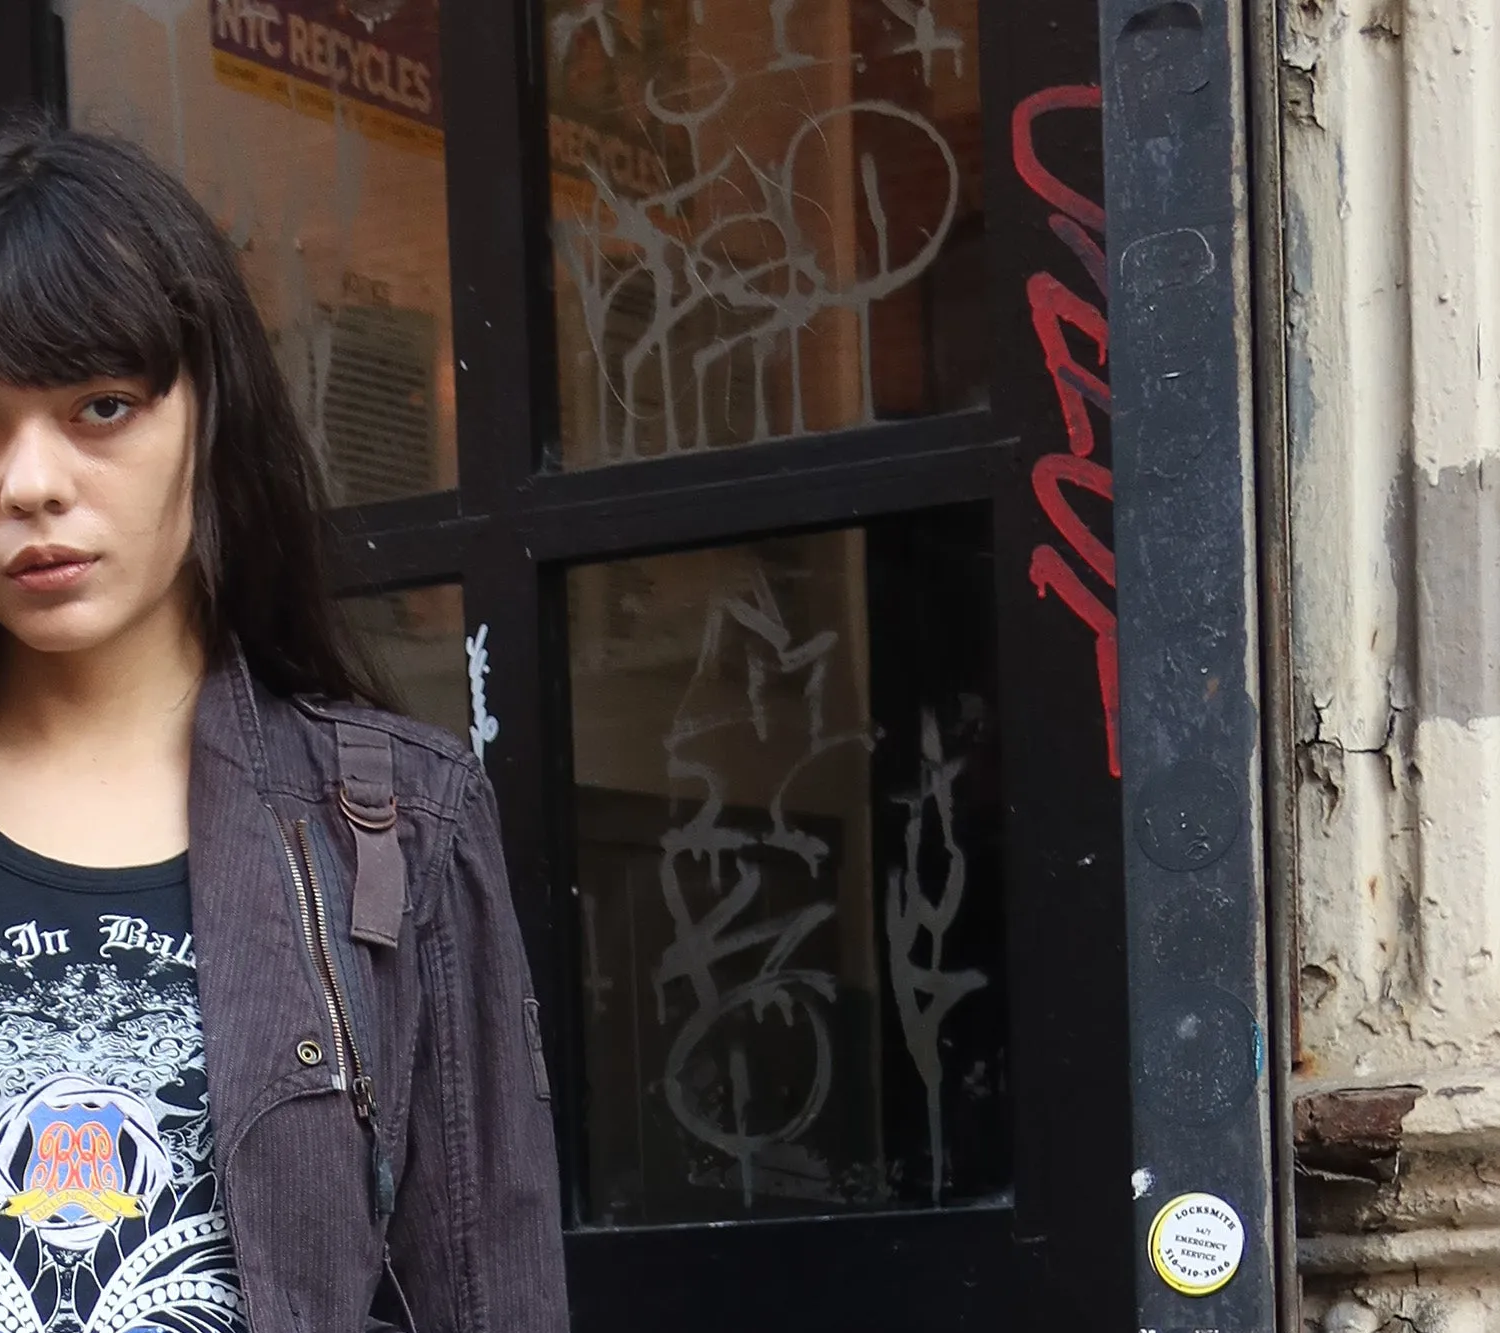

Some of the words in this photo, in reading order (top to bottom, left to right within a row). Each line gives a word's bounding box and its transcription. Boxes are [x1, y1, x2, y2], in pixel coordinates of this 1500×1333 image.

[212, 0, 284, 59] NYC
[288, 13, 432, 115] RECYCLES
[4, 919, 71, 967] In
[1174, 1206, 1237, 1232] LOCKSMITH
[1174, 1234, 1228, 1252] EMERGENCY
[1180, 1248, 1217, 1262] SERVICE
